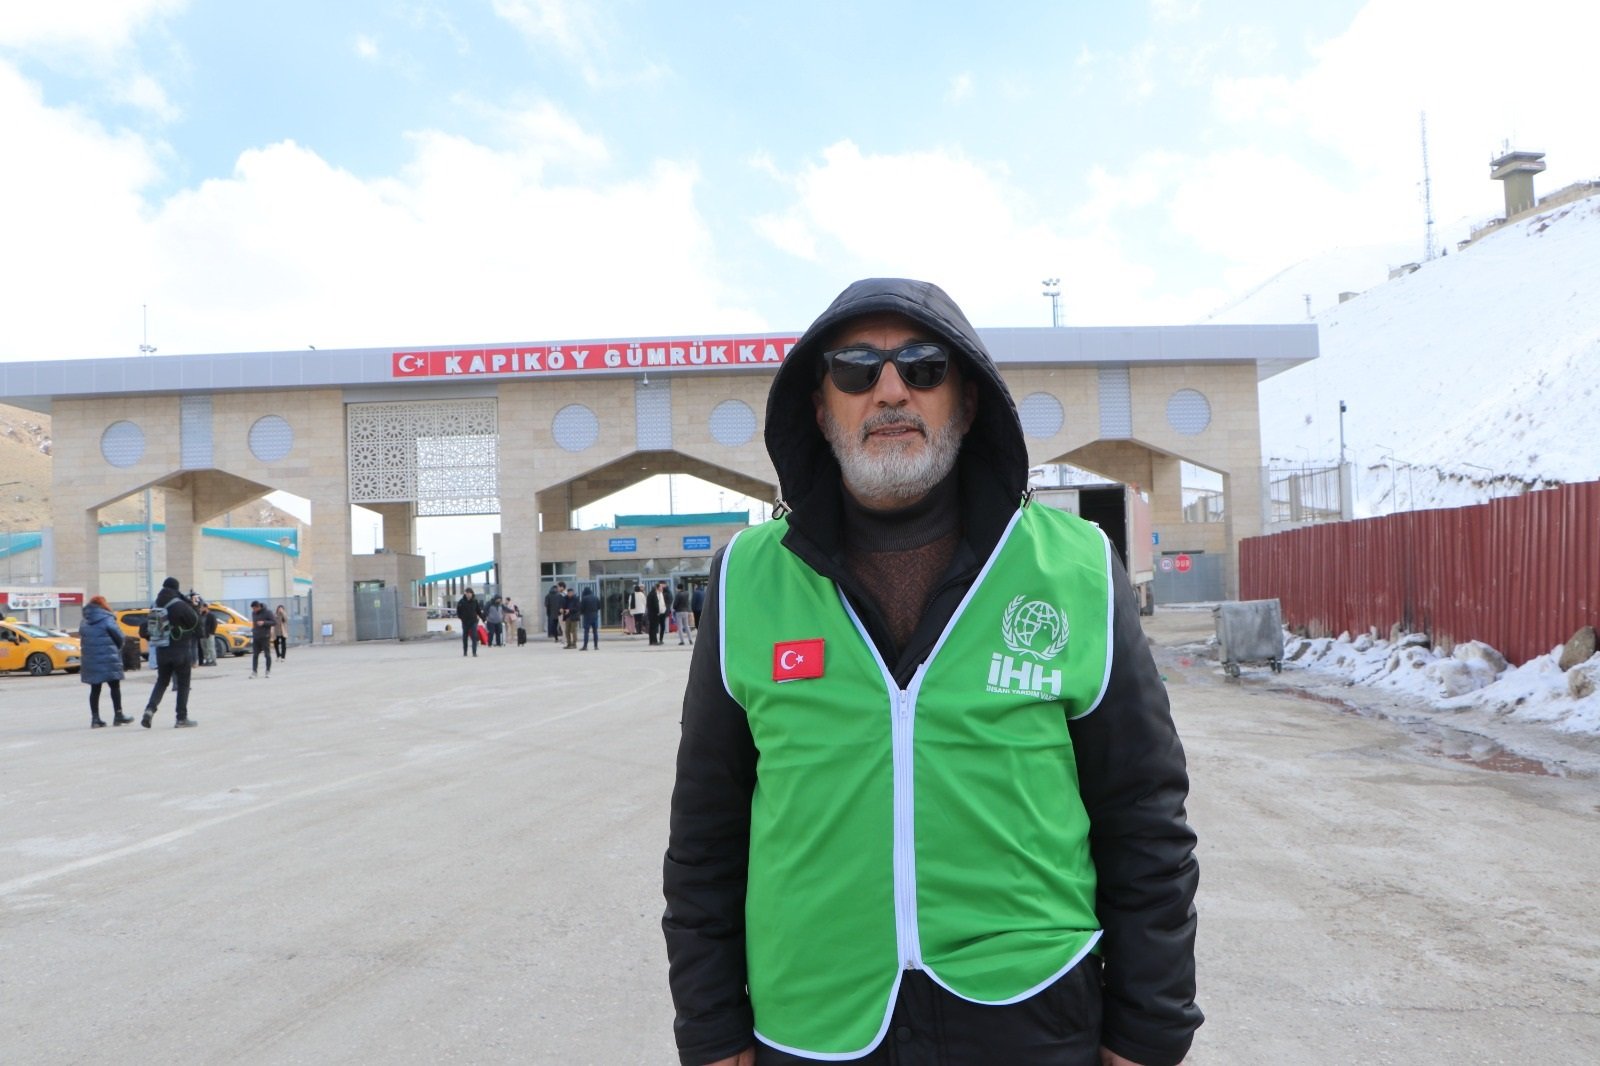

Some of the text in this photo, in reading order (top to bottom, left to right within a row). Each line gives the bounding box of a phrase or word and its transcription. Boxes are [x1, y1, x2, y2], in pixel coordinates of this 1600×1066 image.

[445, 346, 590, 374] KAPIKÖY
[604, 341, 728, 368] GÜMRÜK
[1175, 559, 1190, 567] DUR
